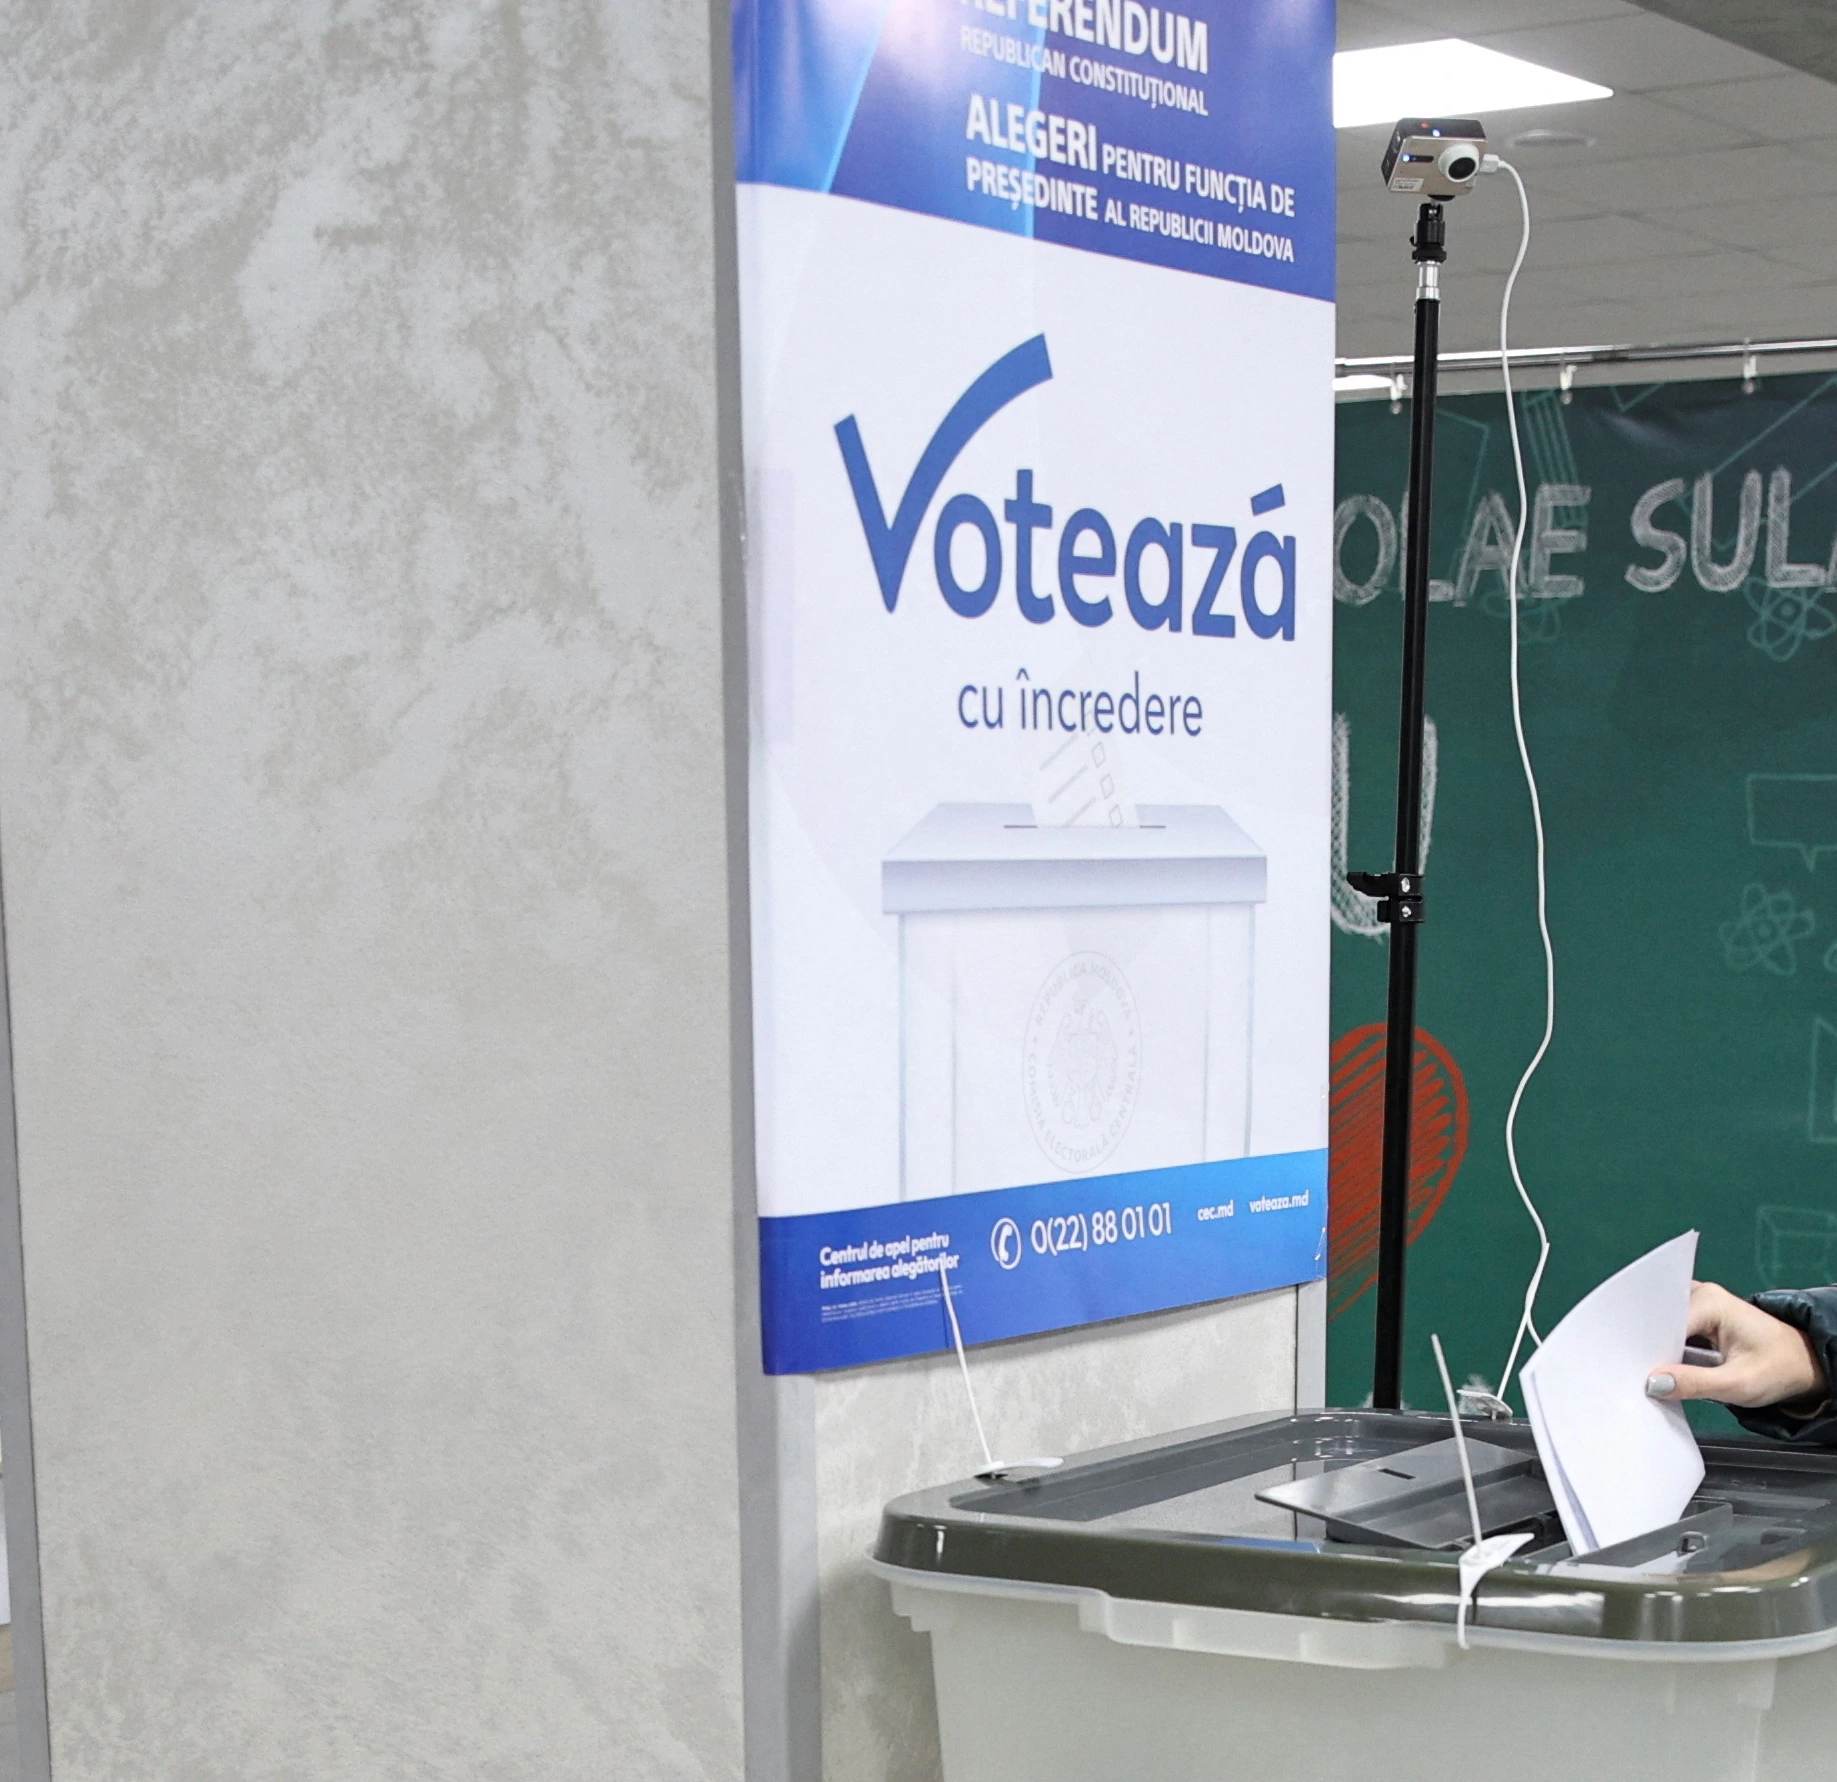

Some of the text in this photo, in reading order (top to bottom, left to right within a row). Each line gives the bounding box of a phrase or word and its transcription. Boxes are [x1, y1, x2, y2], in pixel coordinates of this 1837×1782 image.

[960, 25, 1208, 116] REPUBLICAN CONSTITUȚIONAL
[966, 94, 1295, 217] ALEGERI PENTRU FUNCȚIA DE
[966, 157, 1295, 262] PREȘEDINTE AL REPUBLICII MOLDOVA
[957, 667, 1203, 736] cu încredere
[1197, 1199, 1234, 1221] cec.md
[1249, 1190, 1309, 1213] voteaza.md
[820, 1231, 950, 1267] Centrul de apel pentru
[1030, 1202, 1172, 1256] 0(22) 88 01 01
[820, 1265, 890, 1290] informarea
